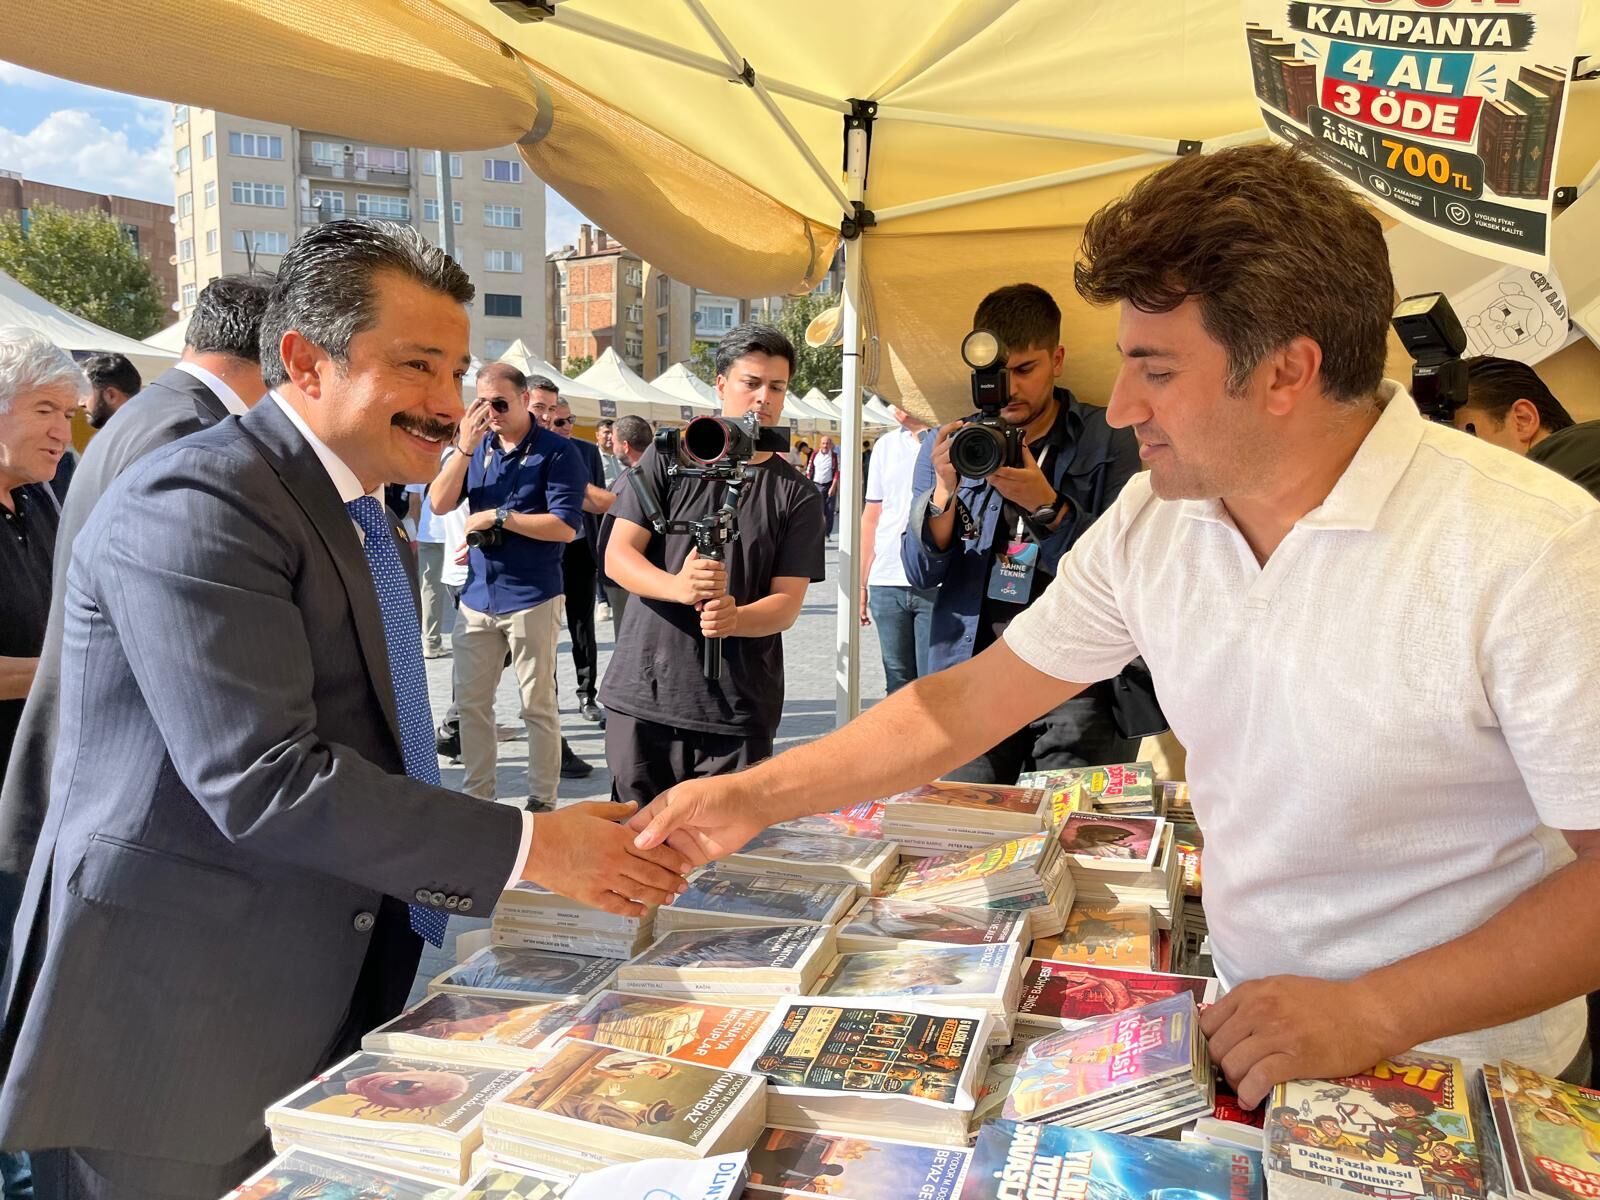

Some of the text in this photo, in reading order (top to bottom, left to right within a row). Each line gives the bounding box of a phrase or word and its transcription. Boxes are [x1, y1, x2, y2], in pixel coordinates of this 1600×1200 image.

[1306, 6, 1512, 47] KAMPANYA
[1342, 50, 1453, 94] 4 AL
[1334, 85, 1460, 135] 3 ÖDE
[1321, 116, 1363, 143] 2. SET
[1323, 129, 1368, 159] ALANA
[1381, 139, 1450, 184] 700
[1452, 172, 1472, 191] TL
[1474, 212, 1516, 227] UYGUN FİYAT
[1475, 219, 1524, 237] YÜKSEK KALİTE
[1530, 271, 1567, 321] CRY BABY
[999, 568, 1025, 579] TEKNİK
[1001, 563, 1026, 572] SAHNE
[1019, 966, 1053, 1013] VİŞNE BAHÇESİ
[693, 1008, 742, 1057] MEKTUPLAR
[715, 1010, 750, 1051] MİLENA'YA
[1112, 1014, 1141, 1077] Kedisi
[1139, 1016, 1163, 1052] Kül
[683, 1072, 737, 1124] KUMARBAZ
[728, 1074, 749, 1098] FYODOR
[925, 1150, 949, 1184] BEYAZ
[948, 1151, 963, 1178] FYODOR
[992, 1123, 1042, 1200] SAVAŞL
[1298, 1148, 1413, 1179] Daha Fazla Nasıl
[1309, 1160, 1405, 1188] Rezil Olunur?
[703, 1162, 737, 1200] DÜN
